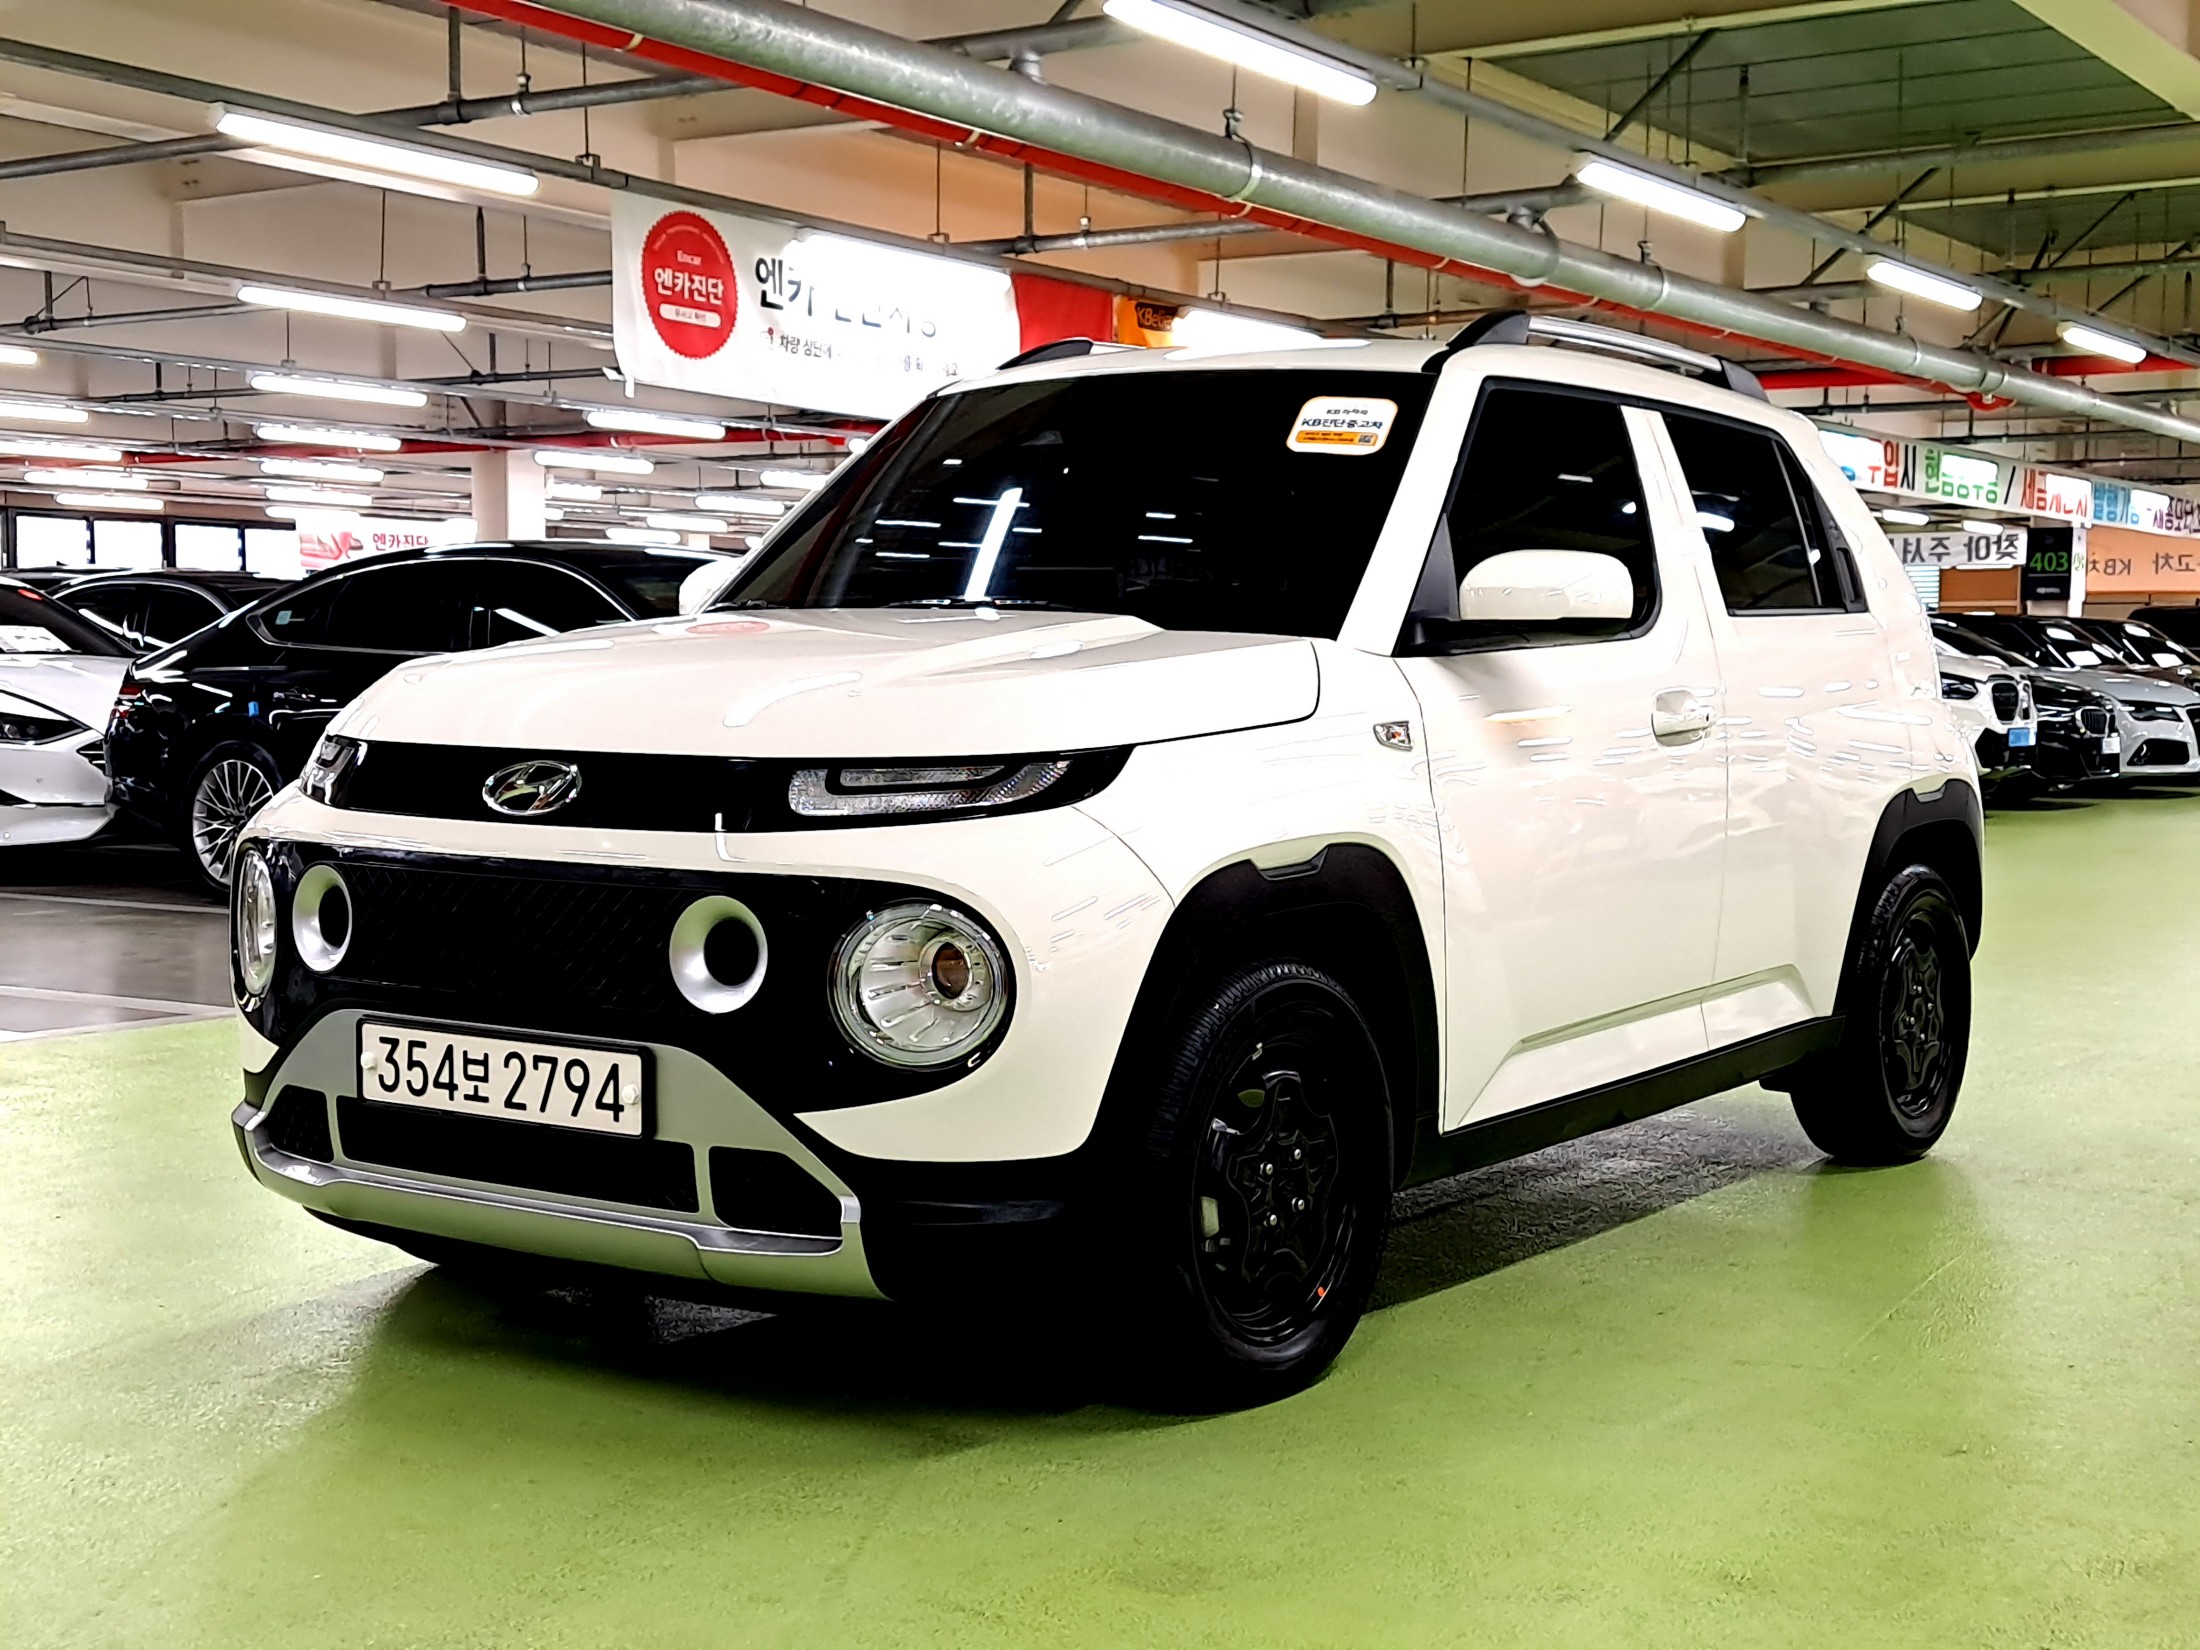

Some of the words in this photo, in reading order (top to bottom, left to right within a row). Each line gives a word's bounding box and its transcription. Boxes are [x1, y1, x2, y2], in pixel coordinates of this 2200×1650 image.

[654, 267, 724, 306] 엔카진단
[779, 334, 801, 354] 차량
[2029, 551, 2069, 572] 403
